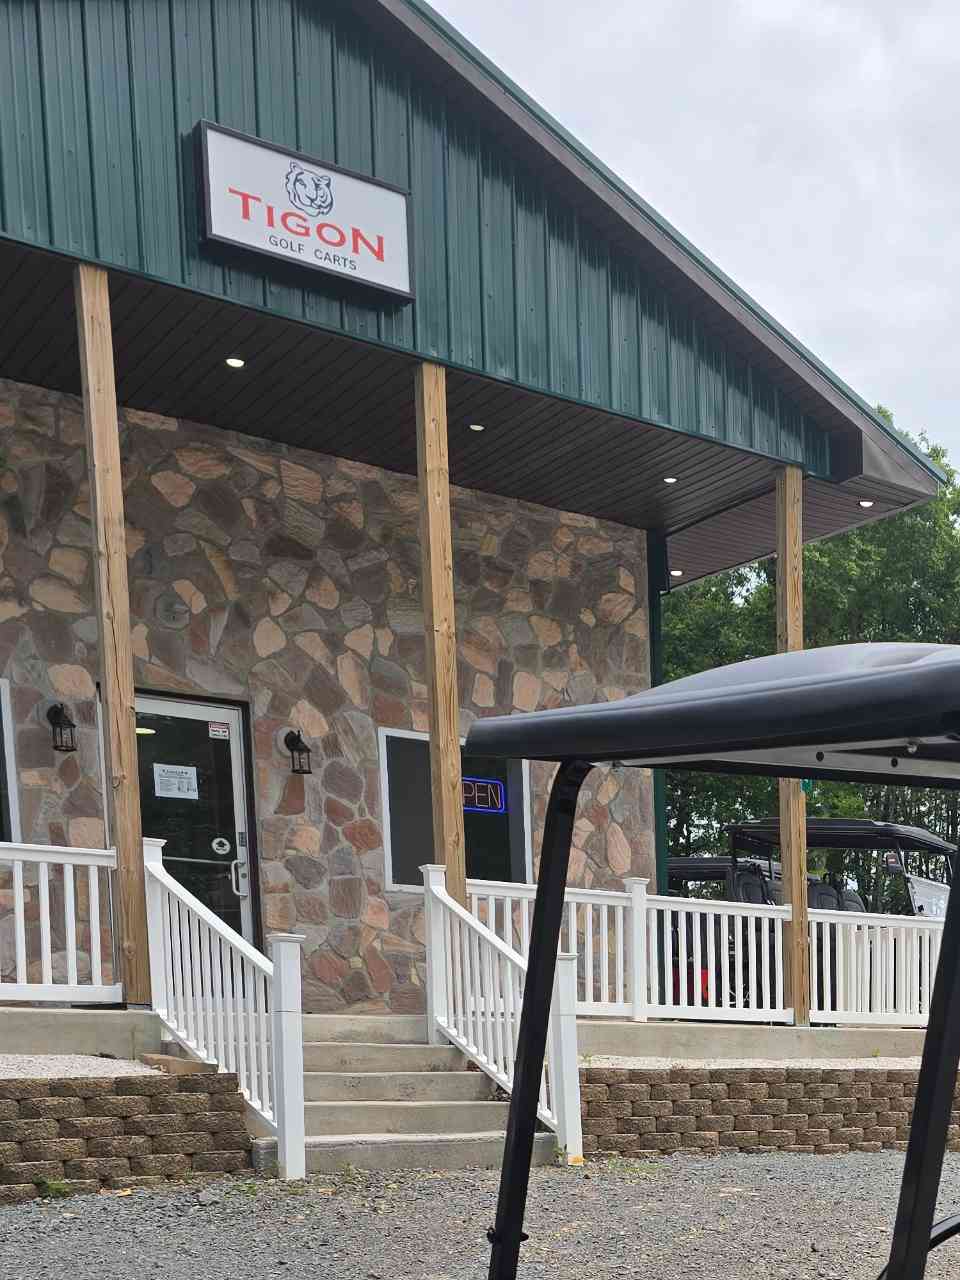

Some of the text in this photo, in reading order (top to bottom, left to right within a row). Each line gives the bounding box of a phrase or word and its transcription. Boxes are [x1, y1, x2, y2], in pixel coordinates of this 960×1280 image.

[228, 187, 385, 262] TIGON
[268, 235, 358, 271] GOLF CARTS
[462, 782, 502, 809] PEN
